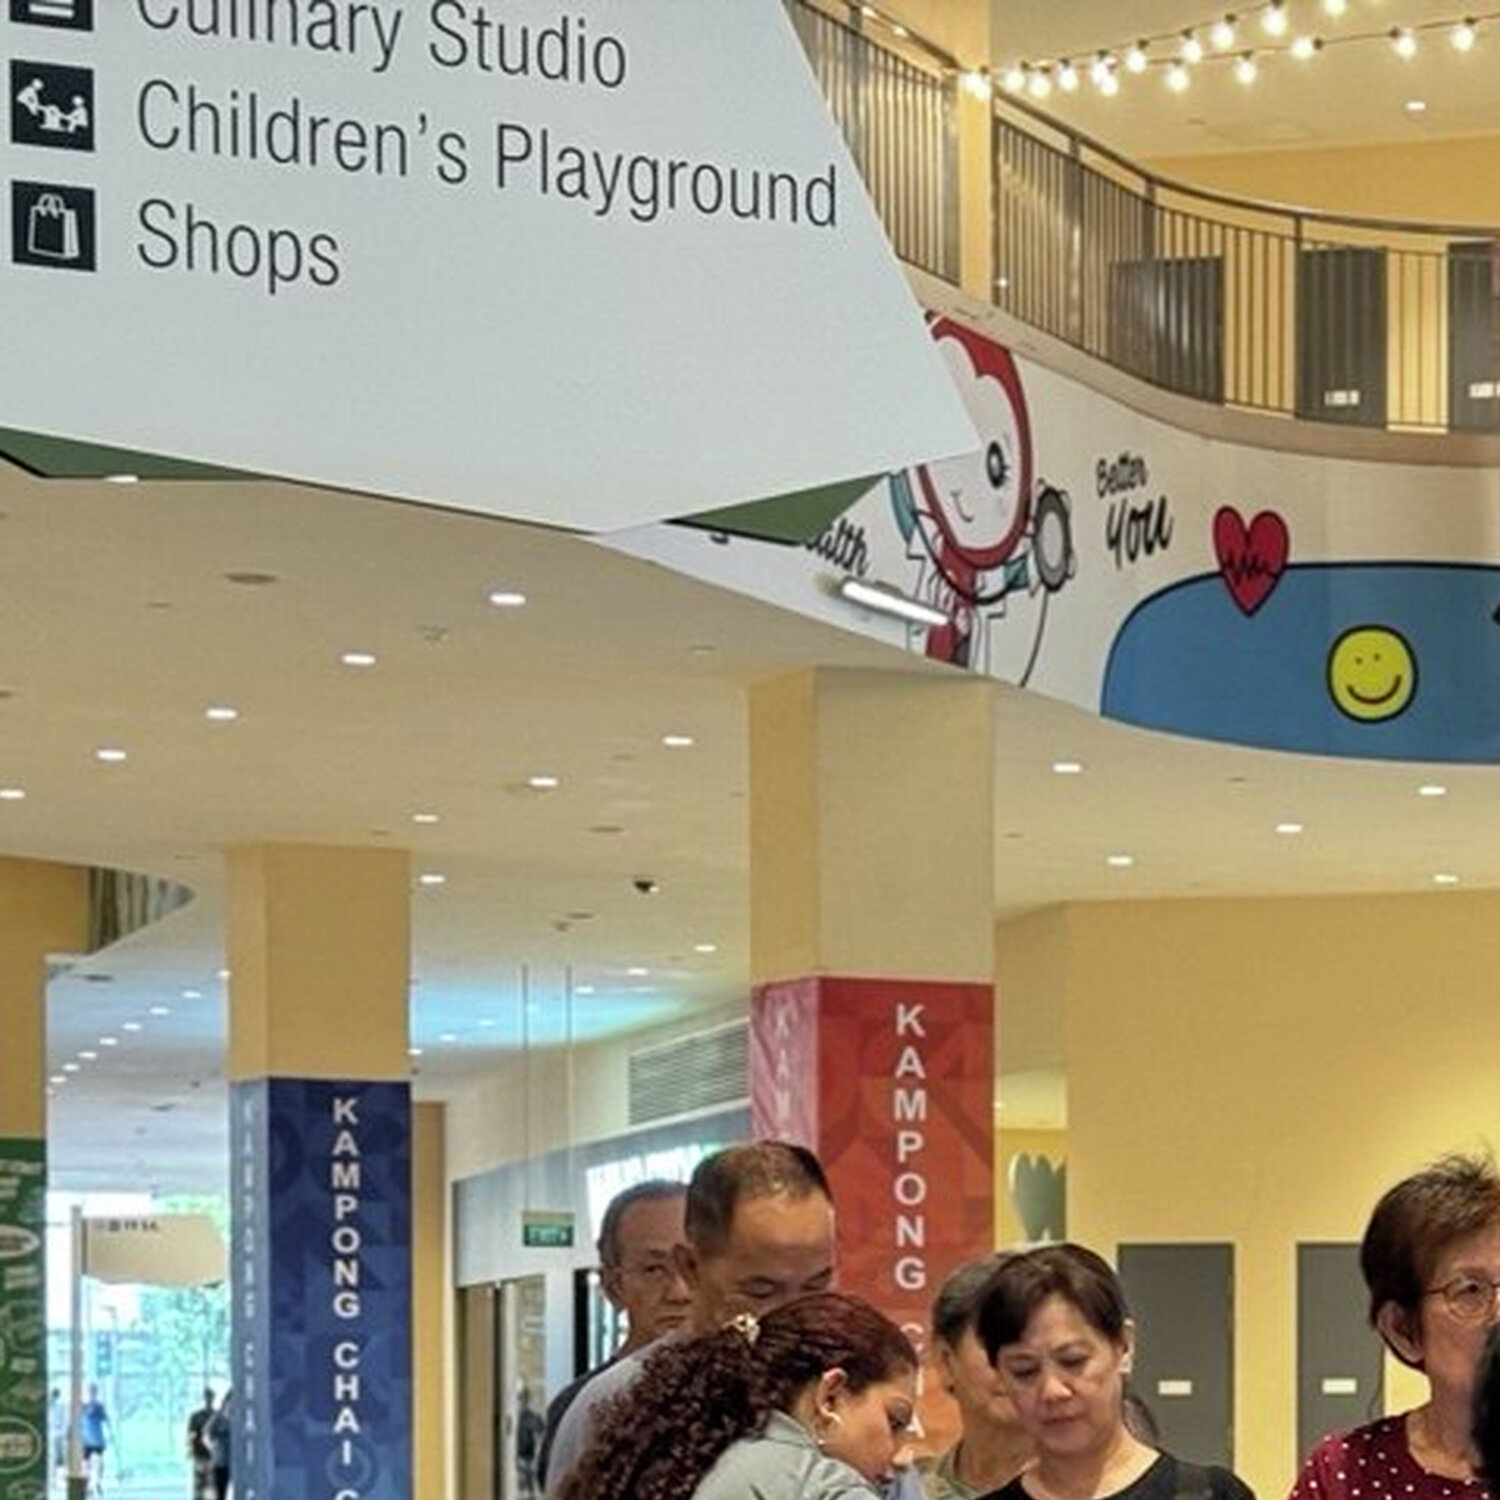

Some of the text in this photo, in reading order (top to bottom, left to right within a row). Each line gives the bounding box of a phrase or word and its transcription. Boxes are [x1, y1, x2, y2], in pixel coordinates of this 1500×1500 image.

[429, 0, 627, 88] Studio
[138, 79, 837, 228] Children's Playground
[138, 199, 341, 293] Shops
[331, 1097, 361, 1319] KAMPONG
[894, 1003, 926, 1290] KAMPONG
[333, 1342, 360, 1466] CHAI
